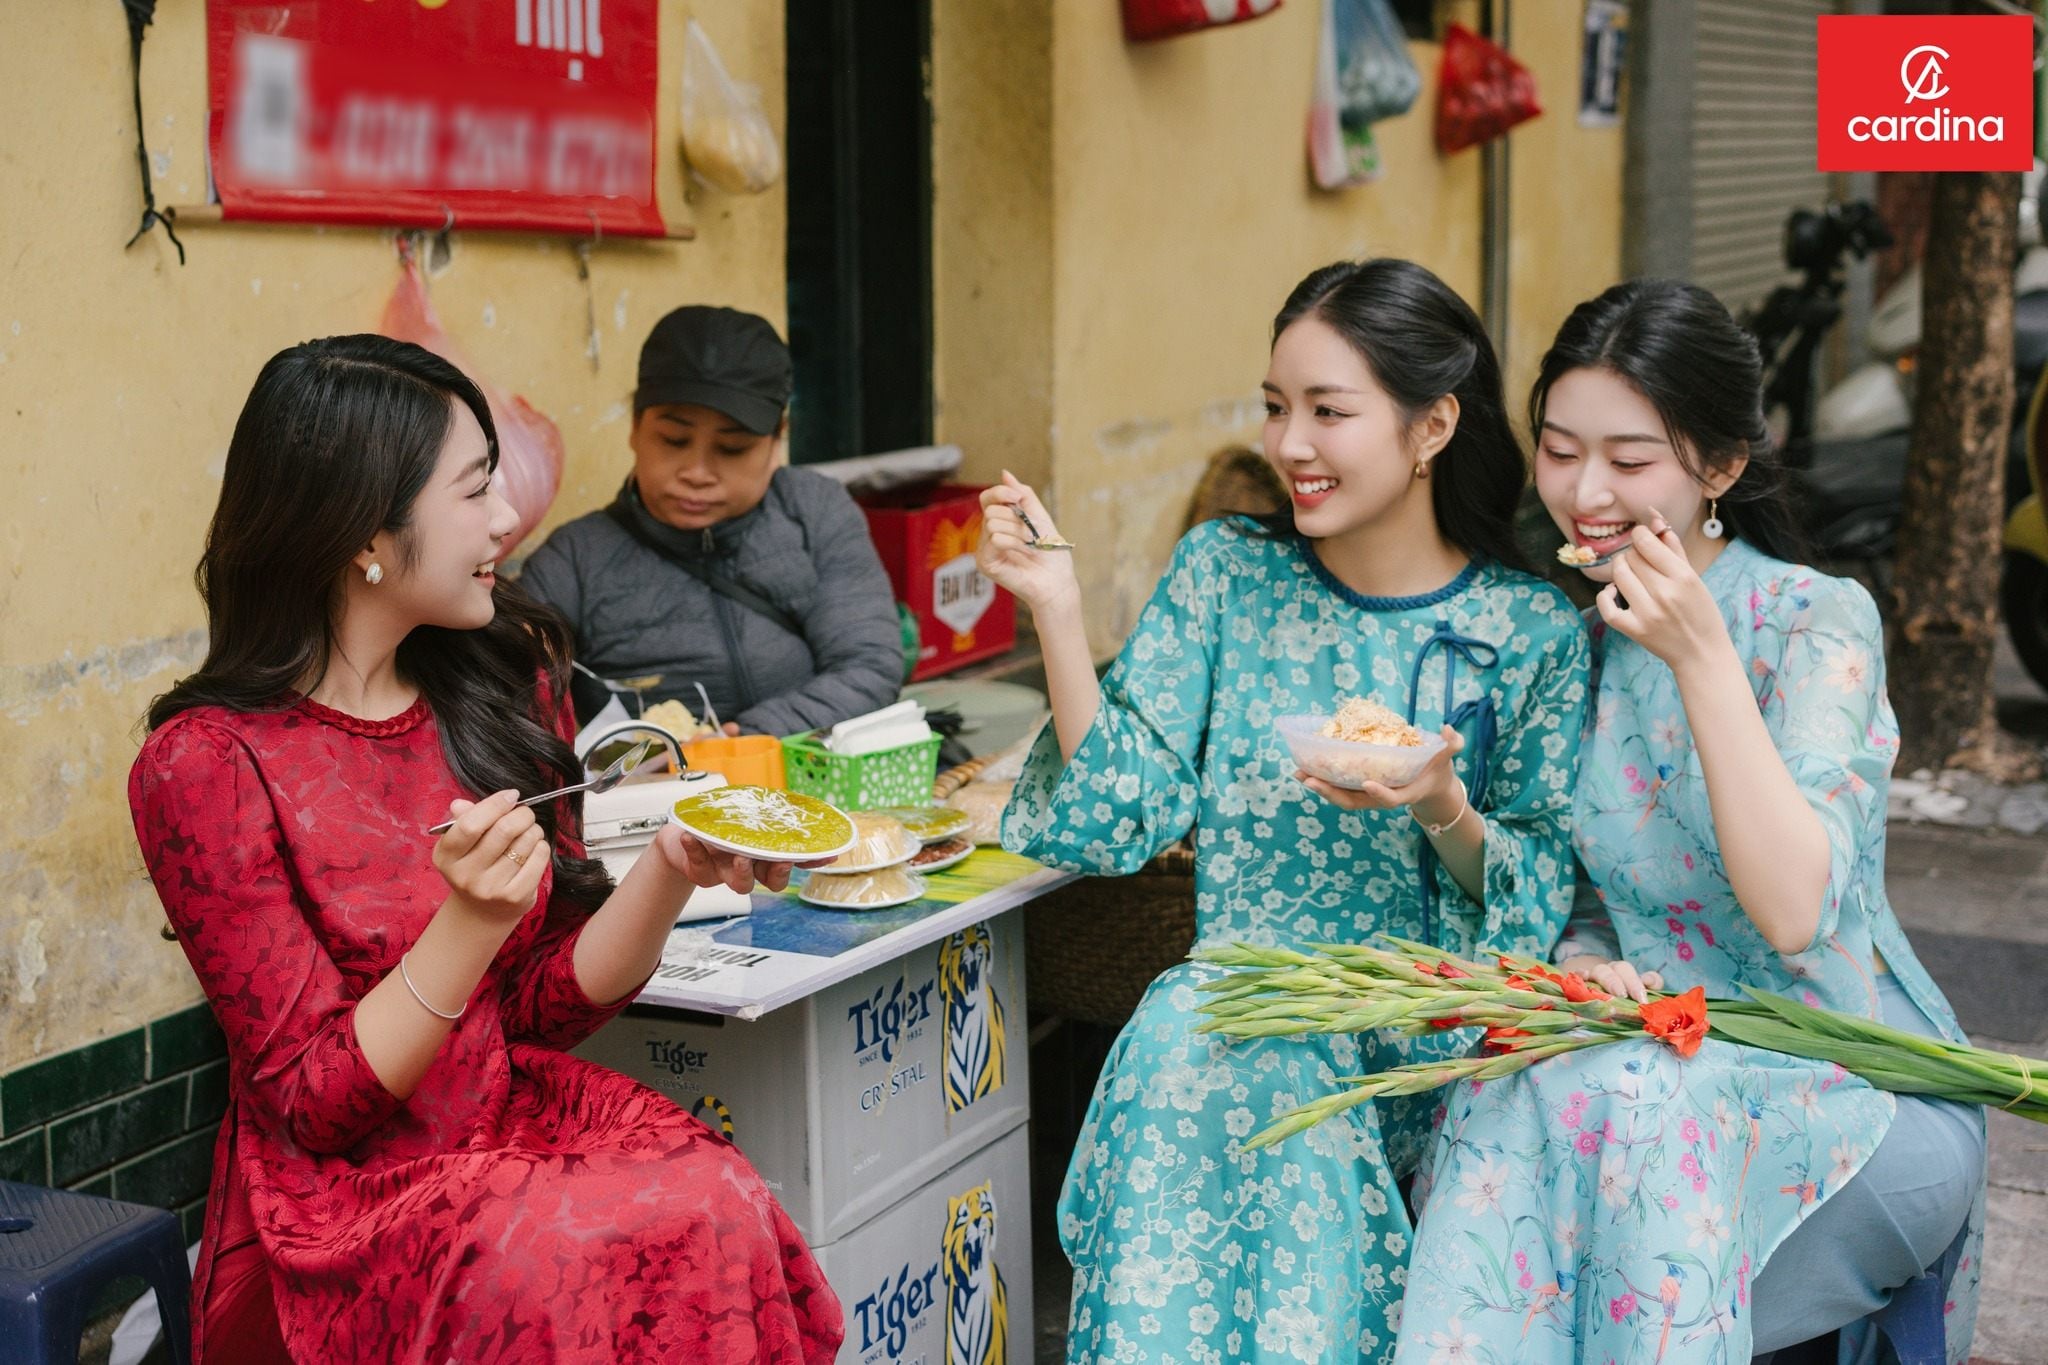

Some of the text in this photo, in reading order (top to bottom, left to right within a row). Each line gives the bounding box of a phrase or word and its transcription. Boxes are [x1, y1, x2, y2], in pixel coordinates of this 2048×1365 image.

[847, 976, 934, 1062] Tiger
[645, 1039, 708, 1075] Tiger
[861, 1063, 927, 1112] CRSTAL
[853, 1262, 938, 1358] Tiger
